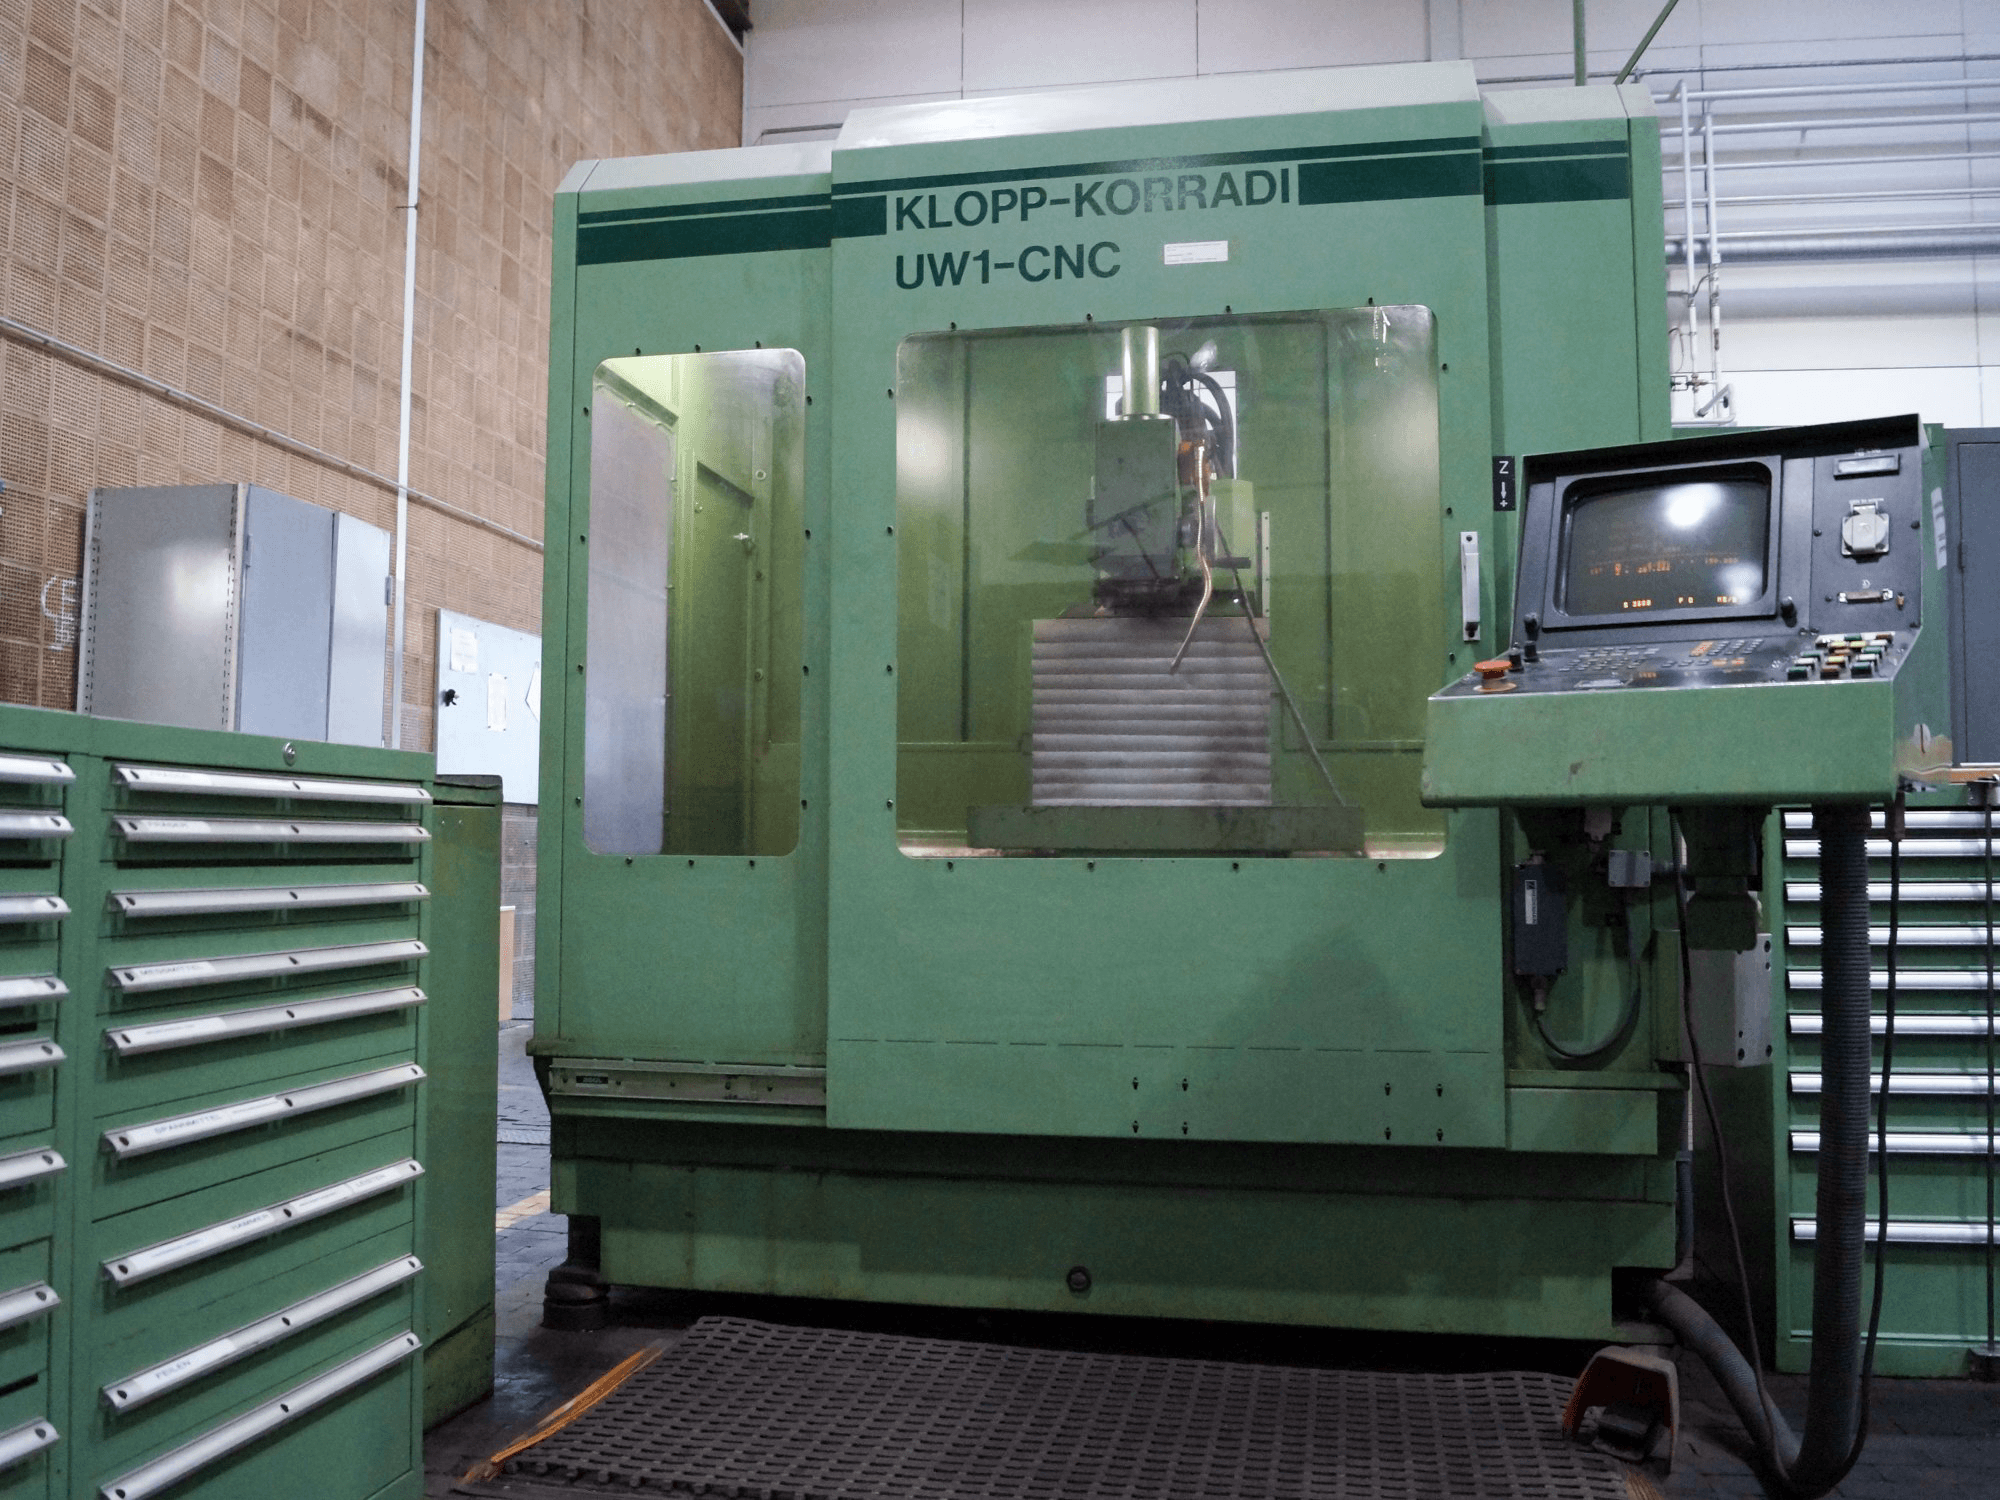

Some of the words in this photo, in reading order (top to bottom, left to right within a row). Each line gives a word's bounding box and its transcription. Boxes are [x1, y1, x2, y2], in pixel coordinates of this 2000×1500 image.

[896, 168, 1290, 231] KLOPP-KORRADI
[896, 241, 1121, 289] UW1-CNC
[1499, 461, 1509, 474] Z
